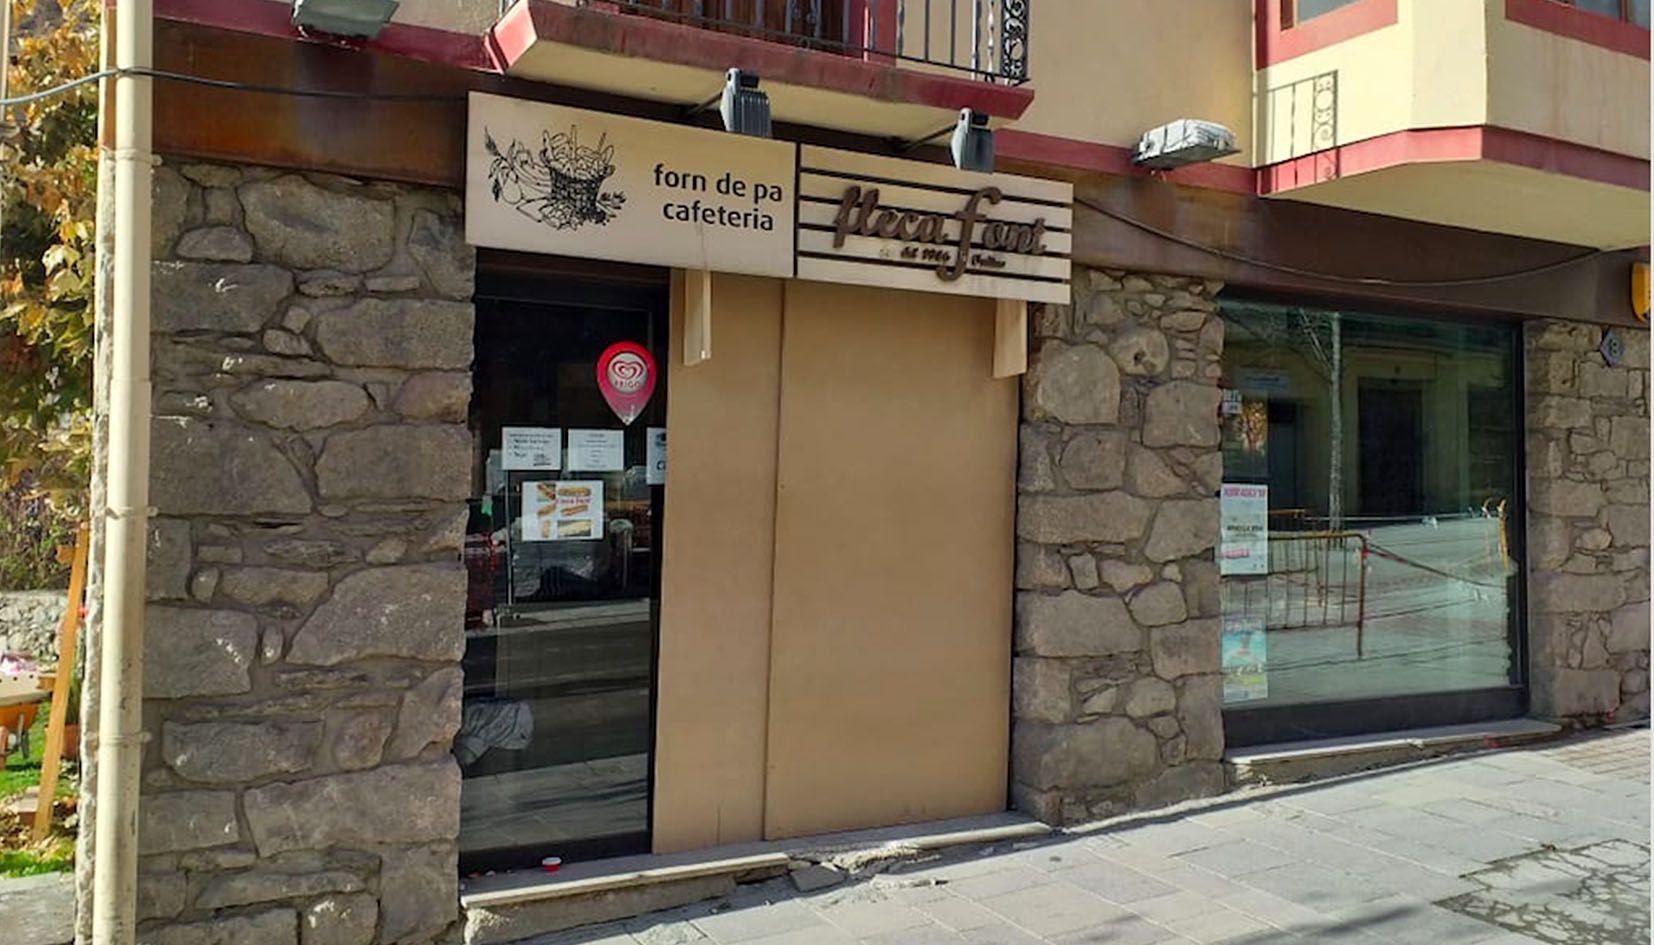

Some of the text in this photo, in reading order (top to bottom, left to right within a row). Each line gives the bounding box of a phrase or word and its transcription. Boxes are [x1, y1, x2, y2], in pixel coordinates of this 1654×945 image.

[653, 163, 783, 204] forn de pa
[663, 200, 774, 231] cafeteria
[832, 185, 949, 249] fleca
